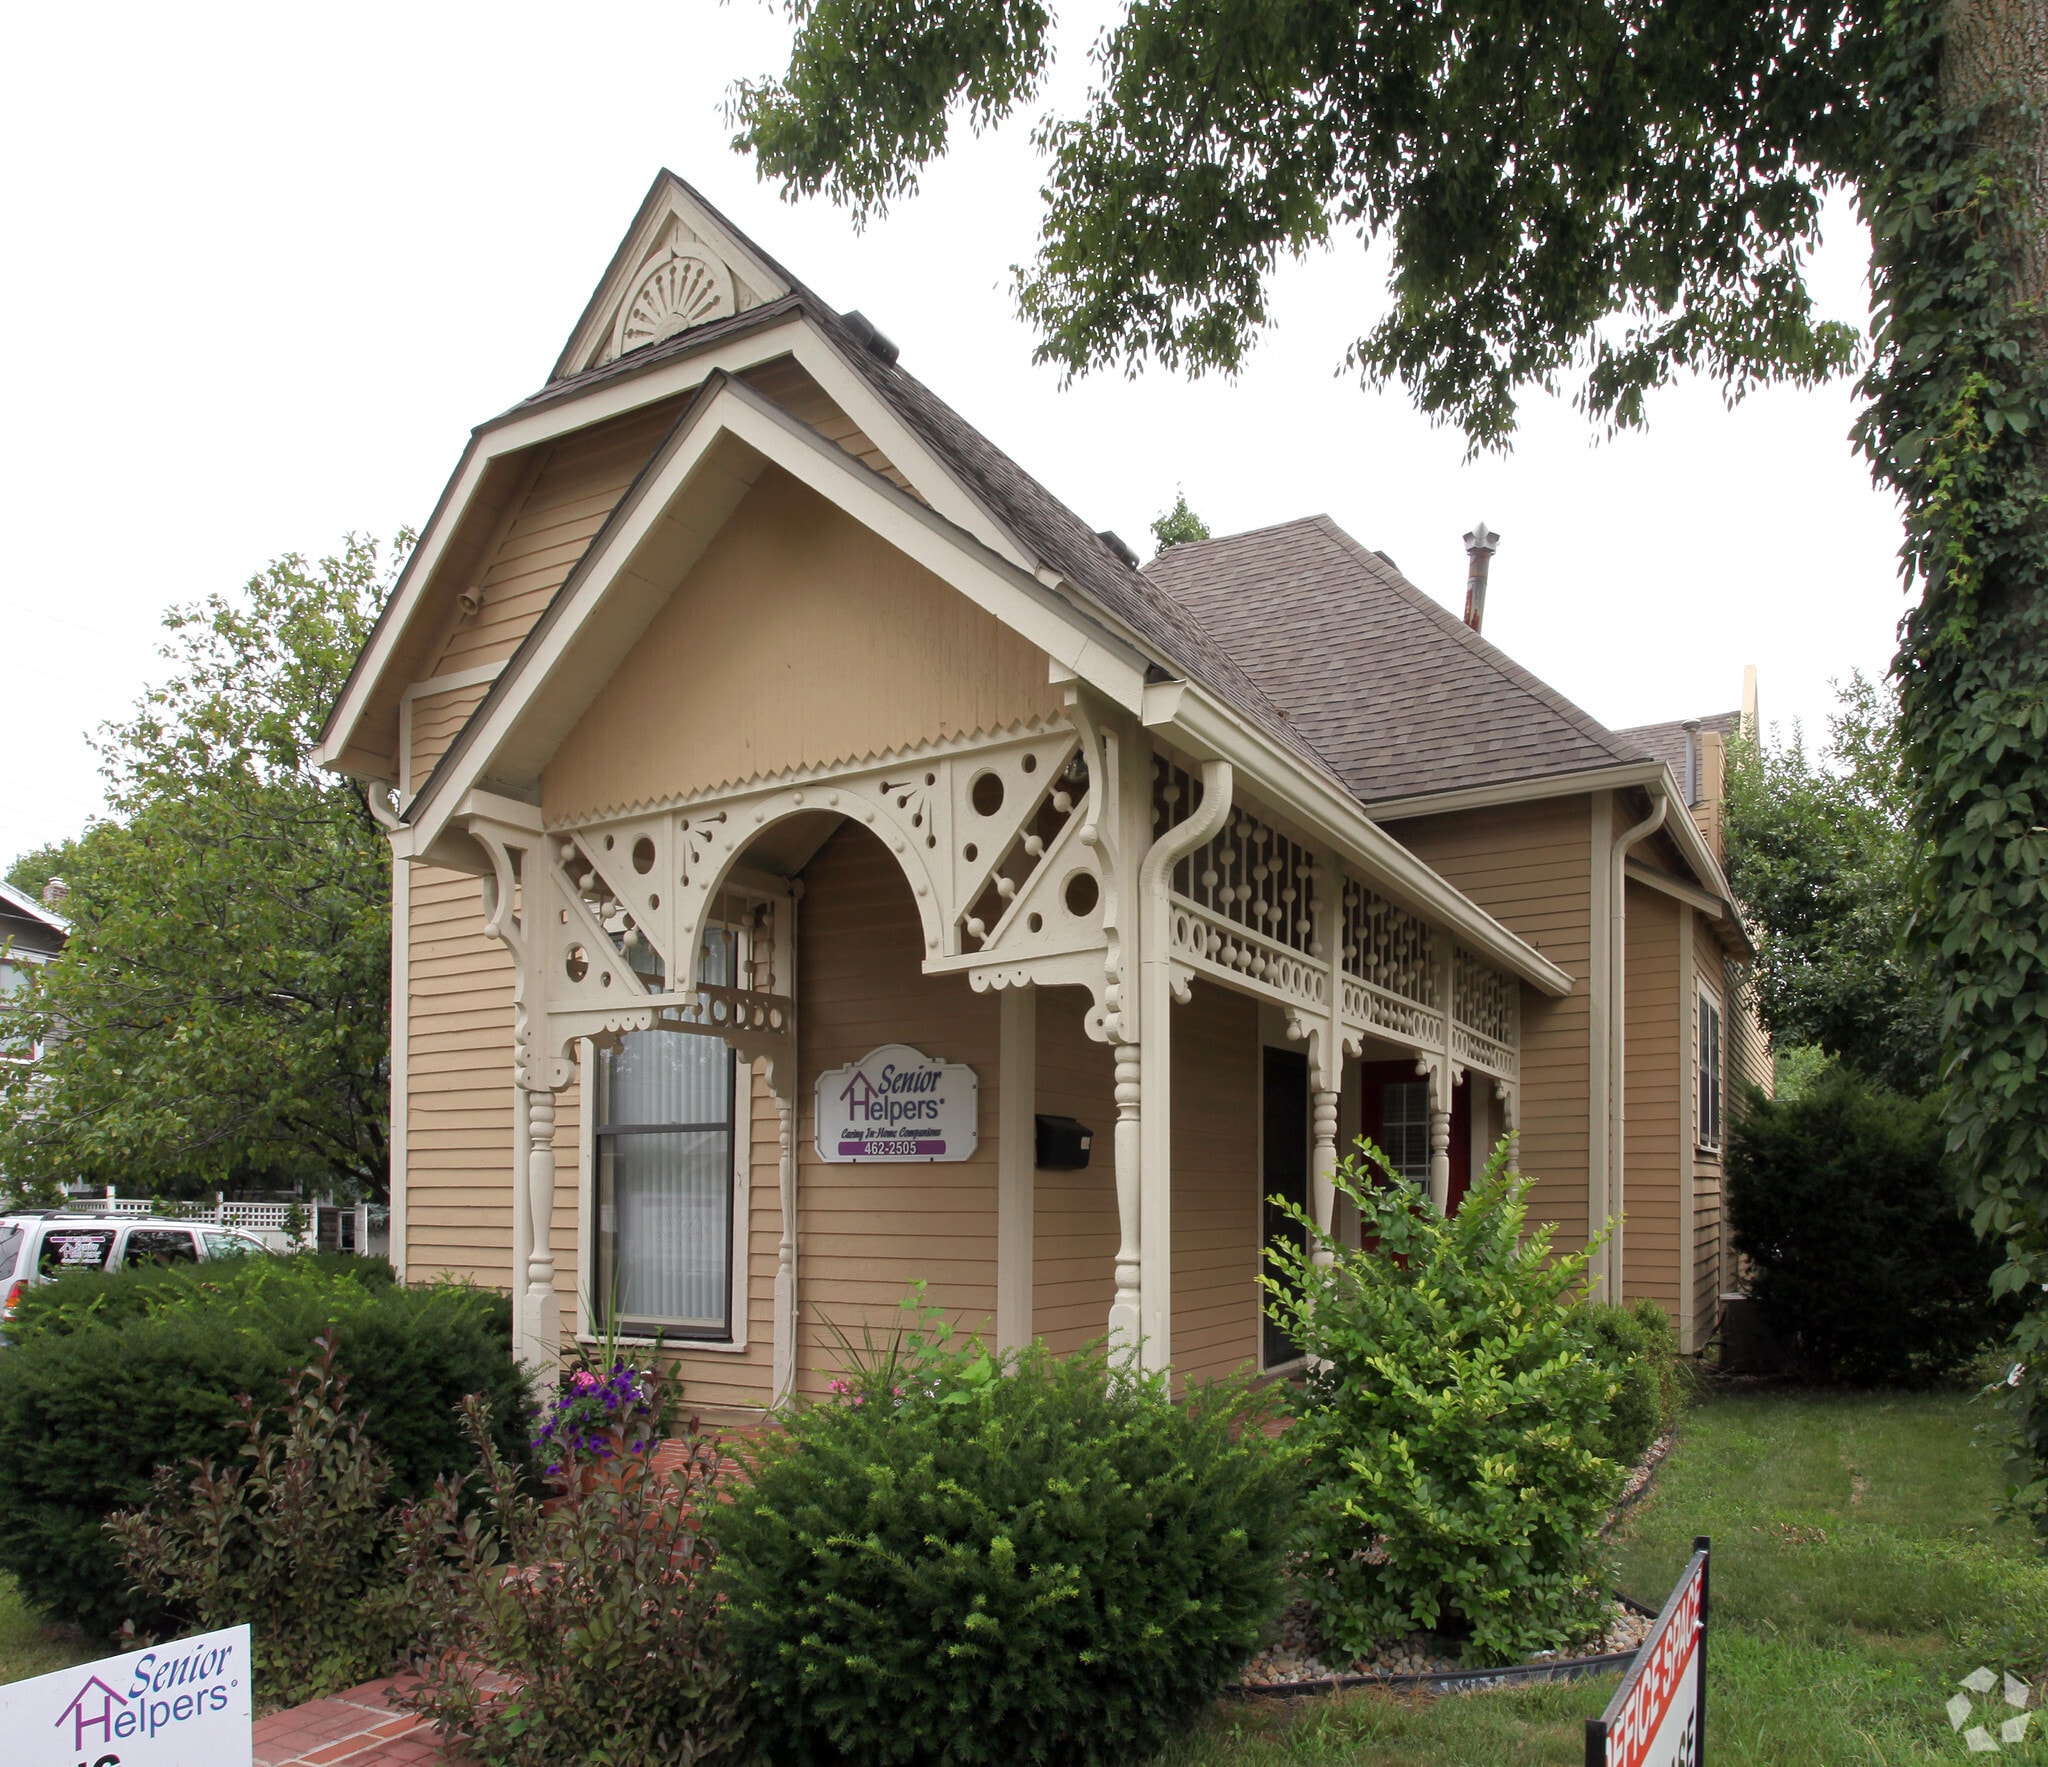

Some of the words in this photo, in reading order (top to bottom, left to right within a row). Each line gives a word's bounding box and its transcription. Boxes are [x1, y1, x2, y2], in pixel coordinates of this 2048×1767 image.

[878, 1064, 942, 1095] Senior
[850, 1087, 939, 1126] Helpers
[841, 1128, 864, 1141] Caring
[899, 1126, 942, 1139] Companions
[864, 1141, 917, 1155] 462-2505
[128, 1644, 233, 1698] Senior
[1606, 1646, 1661, 1767] FFICE
[1662, 1570, 1702, 1698] SPACE
[75, 1685, 228, 1751] Helpers
